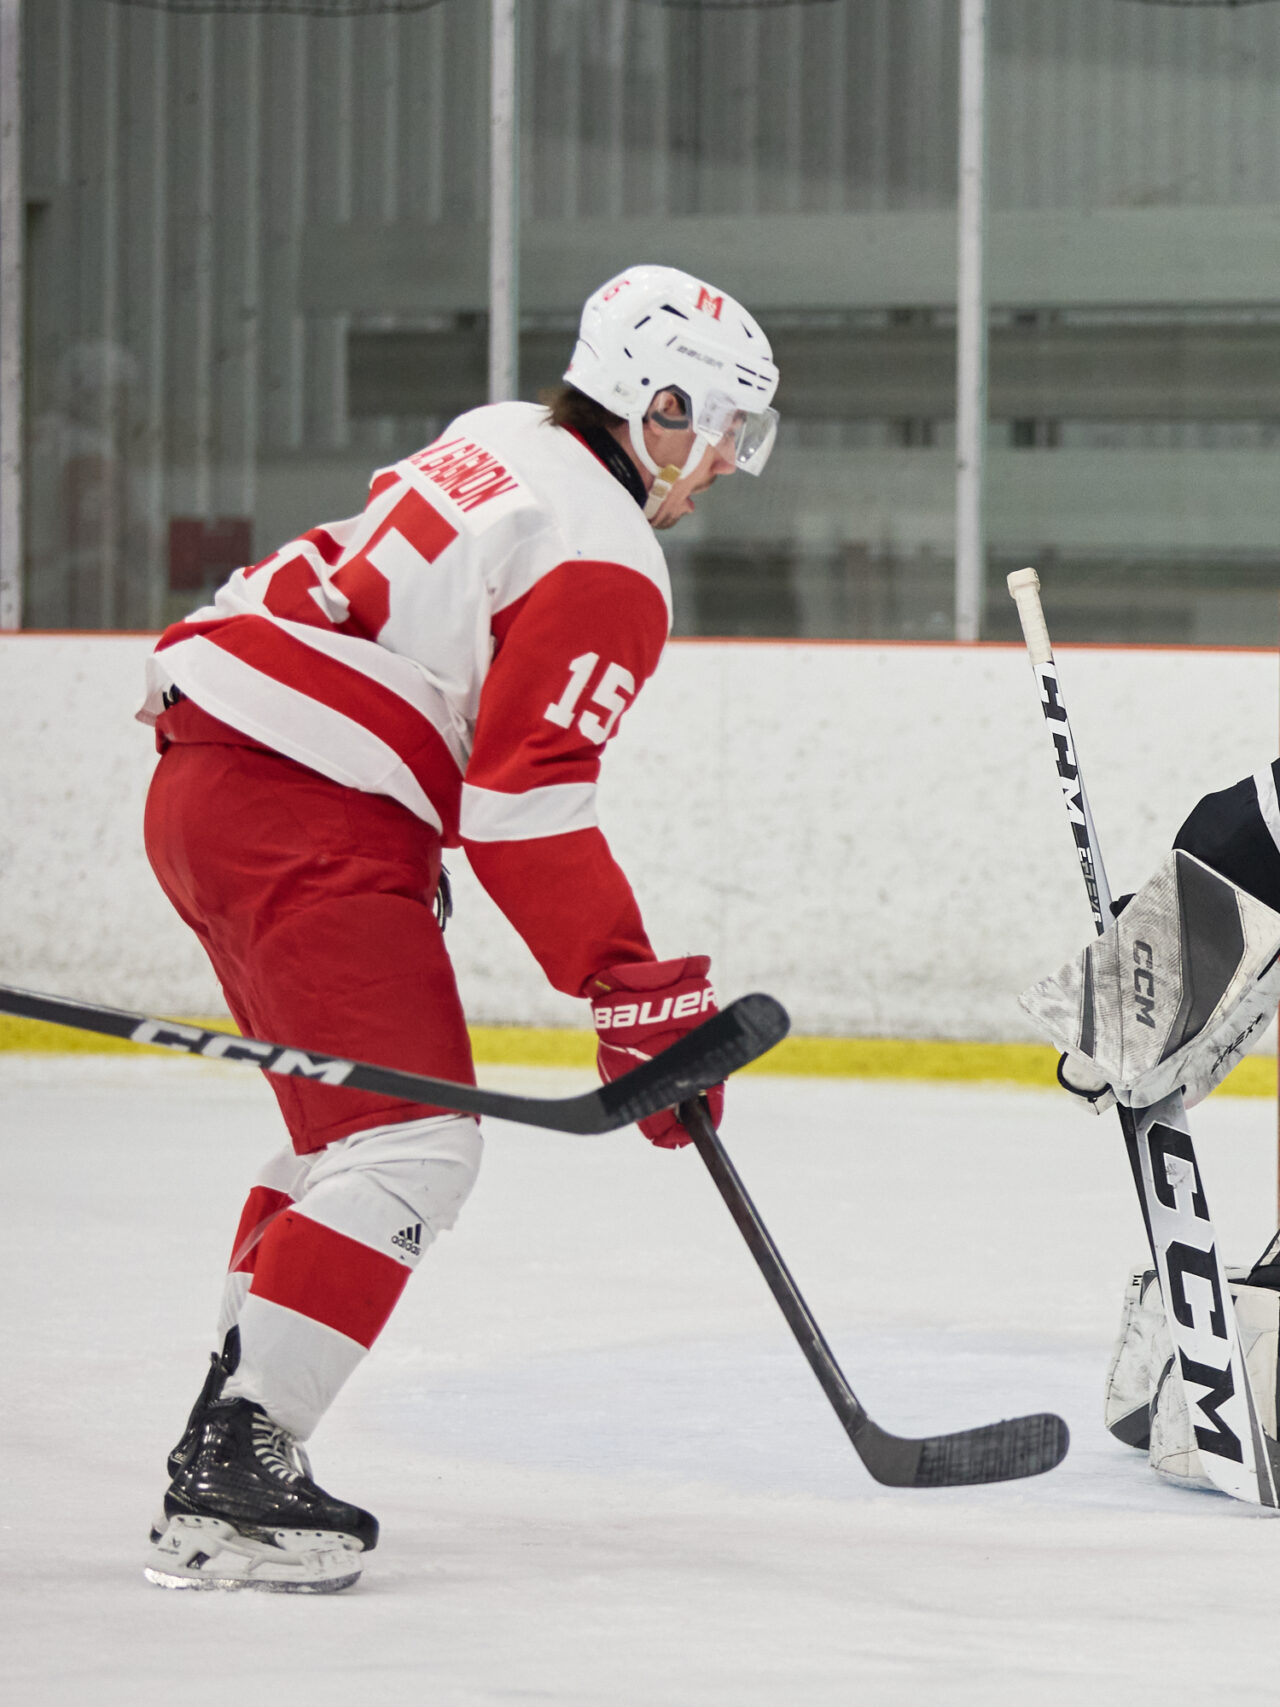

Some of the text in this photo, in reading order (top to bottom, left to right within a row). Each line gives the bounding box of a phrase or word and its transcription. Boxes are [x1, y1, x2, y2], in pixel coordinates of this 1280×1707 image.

[543, 651, 635, 746] 15
[594, 986, 719, 1029] BAUER
[1133, 939, 1156, 1029] CCM
[130, 1018, 356, 1086] CCM
[391, 1235, 420, 1256] adidas
[1147, 1121, 1244, 1464] CCM
